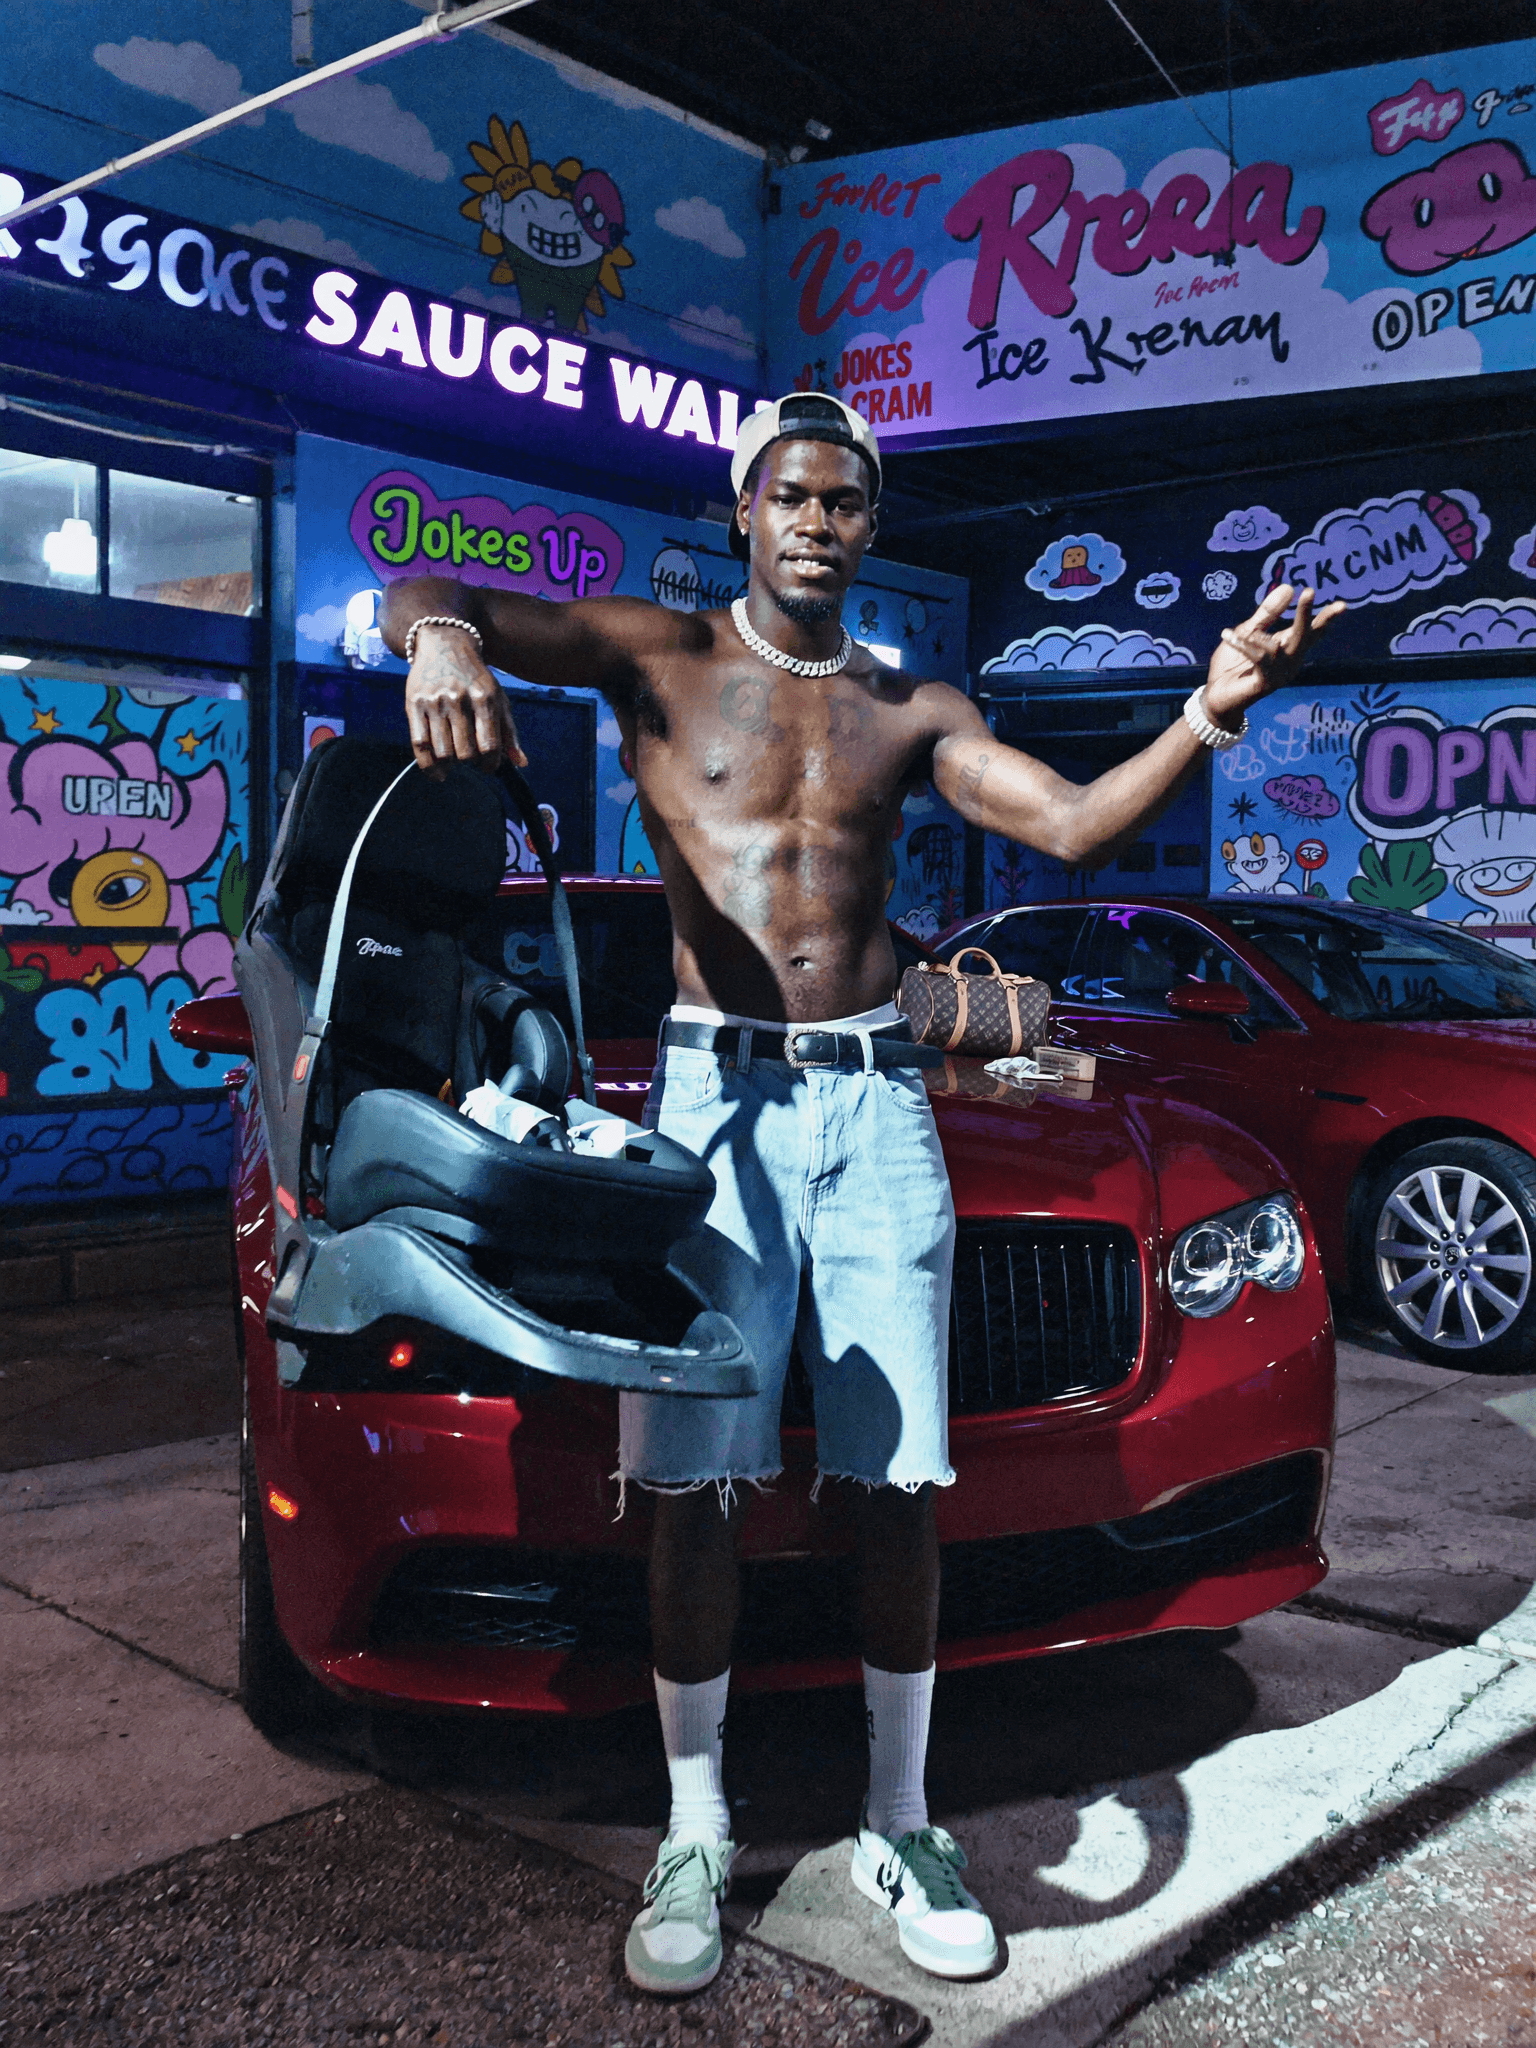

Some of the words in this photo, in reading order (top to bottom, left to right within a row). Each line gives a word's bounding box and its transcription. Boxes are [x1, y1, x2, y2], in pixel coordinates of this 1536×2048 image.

[1373, 273, 1536, 353] OPEN
[305, 271, 587, 409] SAUCE
[609, 357, 776, 452] WAL
[833, 341, 912, 389] JOKES
[963, 330, 1050, 389] Ice
[370, 484, 533, 574] Jokes
[541, 527, 609, 598] Up
